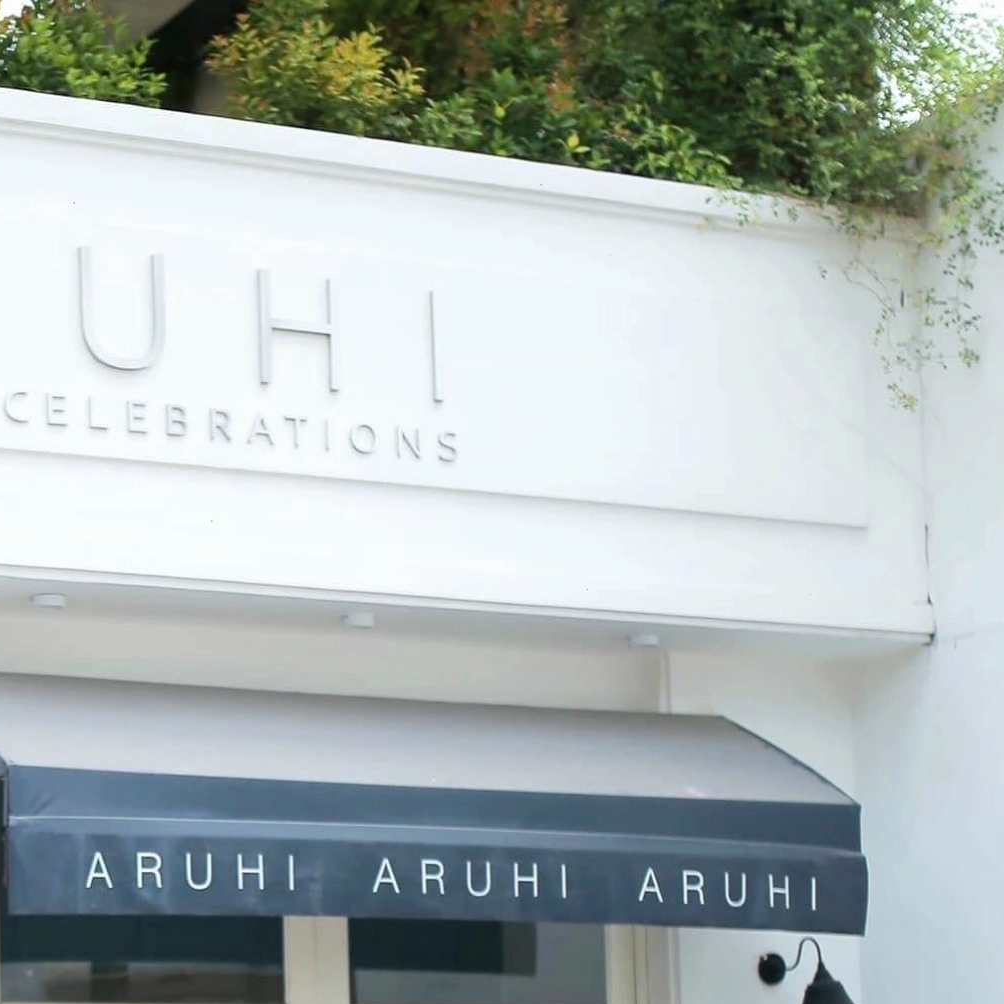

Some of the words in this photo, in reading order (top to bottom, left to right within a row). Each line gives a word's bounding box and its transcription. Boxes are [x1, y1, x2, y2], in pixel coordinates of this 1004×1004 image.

[86, 852, 295, 890] ARUHI
[372, 857, 566, 898] ARUHI
[639, 867, 816, 911] ARUHI
